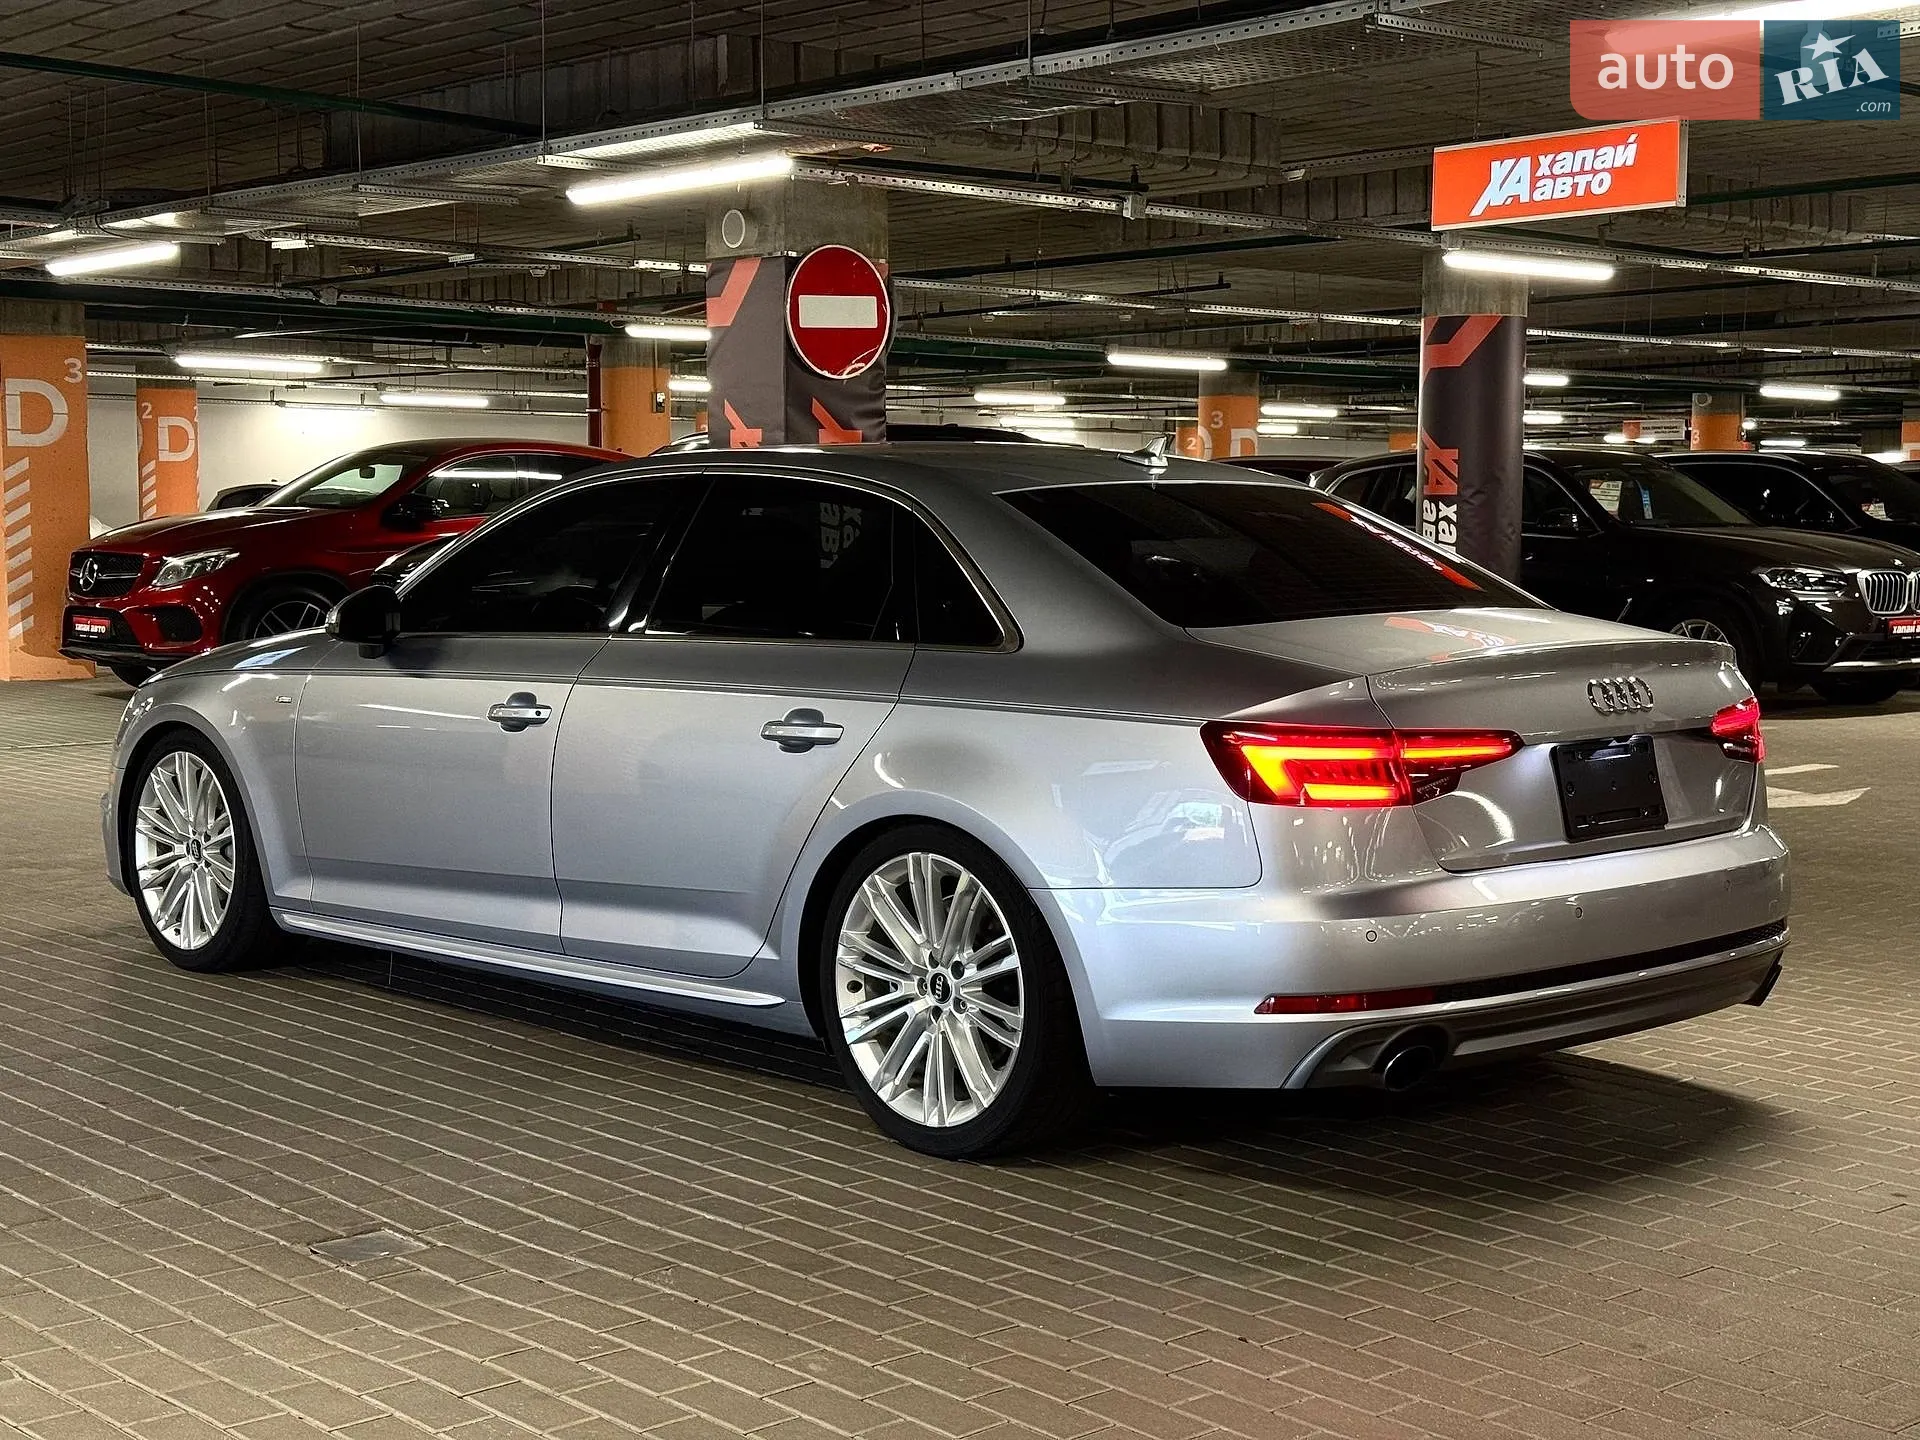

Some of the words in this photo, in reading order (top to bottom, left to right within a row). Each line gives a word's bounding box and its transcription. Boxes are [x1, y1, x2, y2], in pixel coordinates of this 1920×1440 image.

[1532, 171, 1613, 202] авто
[64, 357, 83, 384] 3
[5, 378, 69, 447] D
[141, 402, 153, 419] 2
[1210, 410, 1224, 429] 3
[157, 416, 196, 462] D
[1186, 437, 1197, 450] 2
